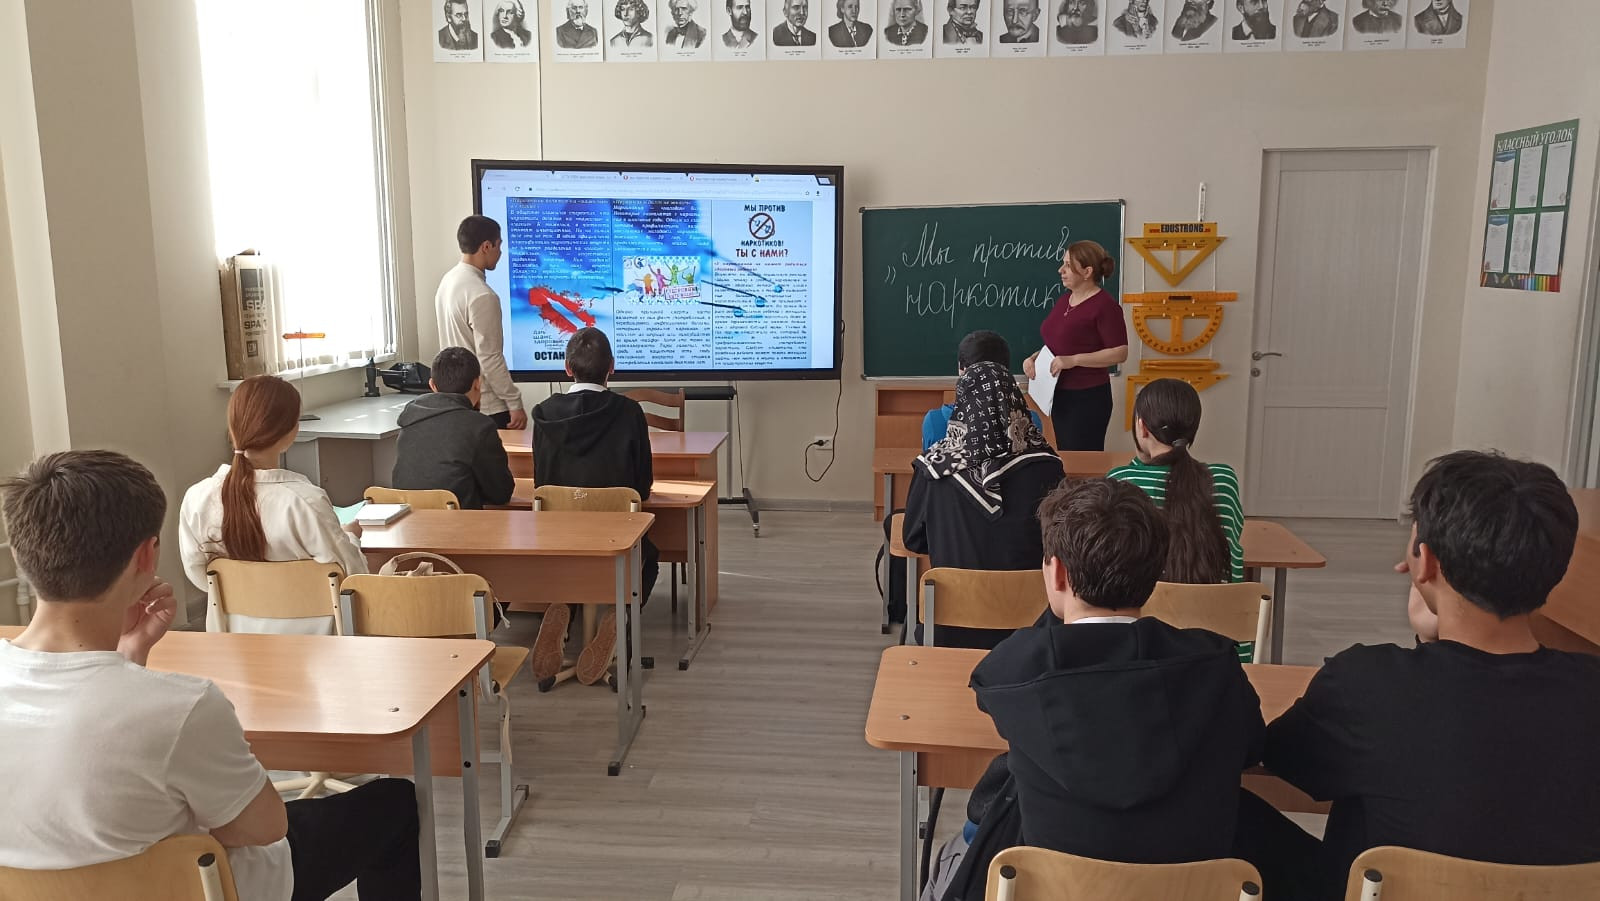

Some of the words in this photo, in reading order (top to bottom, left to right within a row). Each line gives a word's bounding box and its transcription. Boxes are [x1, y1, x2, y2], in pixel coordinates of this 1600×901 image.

[1496, 131, 1539, 152] КЛАССНЫЙ
[1540, 128, 1575, 145] УГОЛОК
[744, 204, 757, 212] МЫ
[759, 204, 786, 212] ПРОТИВ
[741, 239, 784, 247] НАРКОТИКОВ!
[735, 248, 748, 258] ТЫ
[751, 248, 757, 258] С
[760, 248, 788, 258] НАМИ?
[973, 226, 1070, 278] против
[906, 277, 1061, 328] наркотик
[534, 351, 565, 360] ОСТАН
